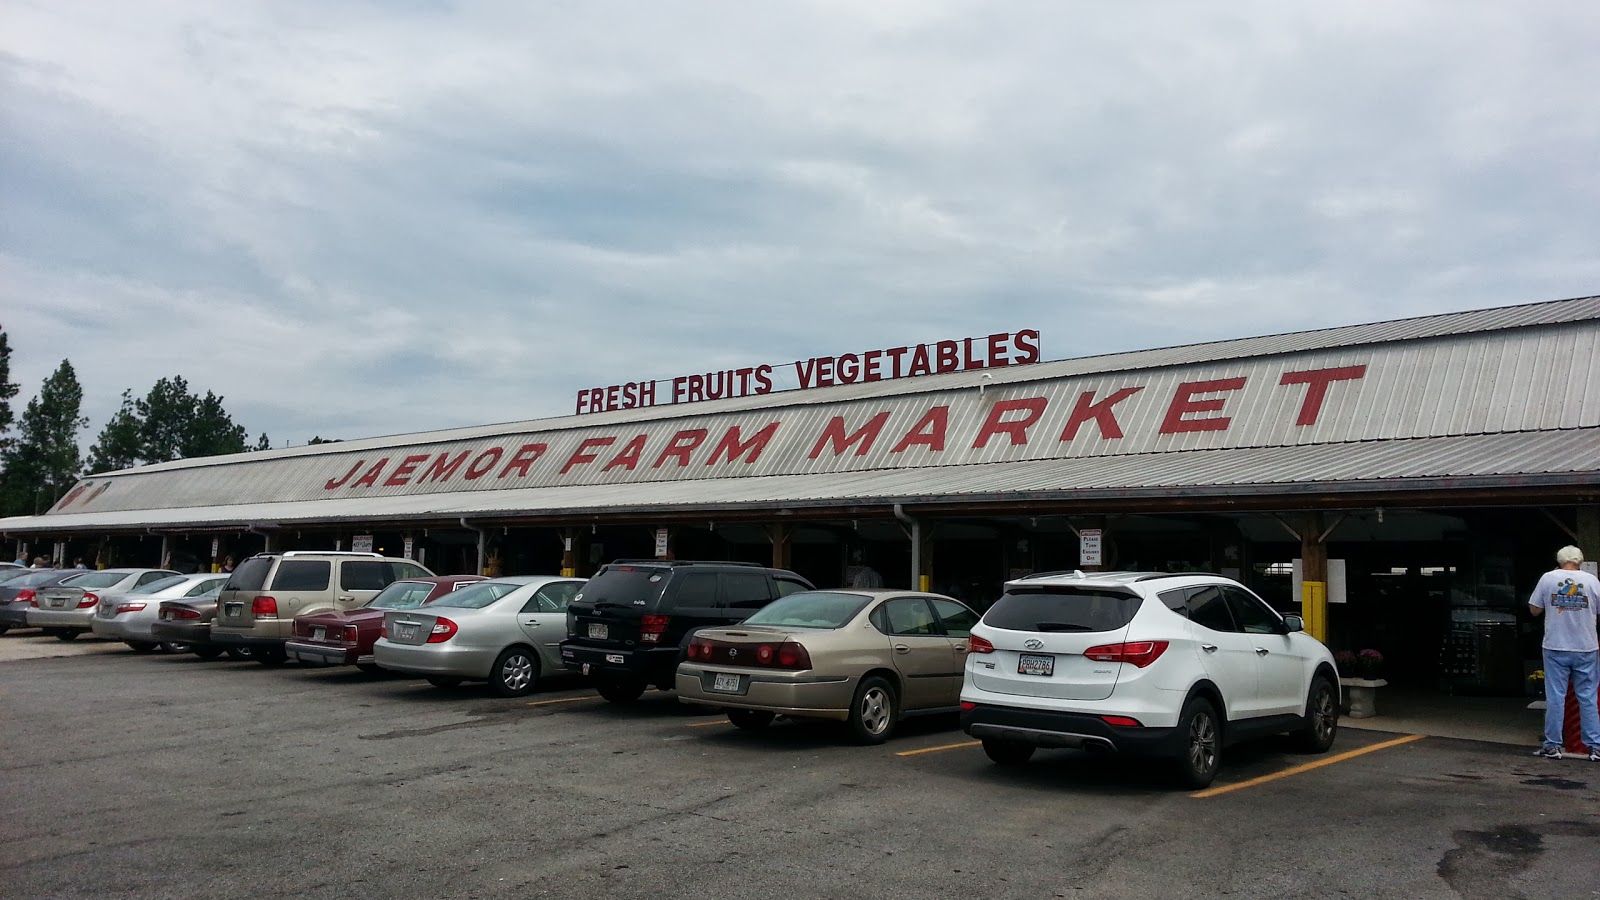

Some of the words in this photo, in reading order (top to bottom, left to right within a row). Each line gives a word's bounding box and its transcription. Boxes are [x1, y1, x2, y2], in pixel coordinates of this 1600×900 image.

[576, 379, 655, 415] FRESH
[673, 364, 773, 405] FRUITS
[795, 329, 1038, 390] VEGETABLES
[324, 442, 548, 491] JAEMOR
[559, 421, 781, 475] FARM
[807, 364, 1367, 460] MARKET
[1021, 658, 1050, 671] PRH2786
